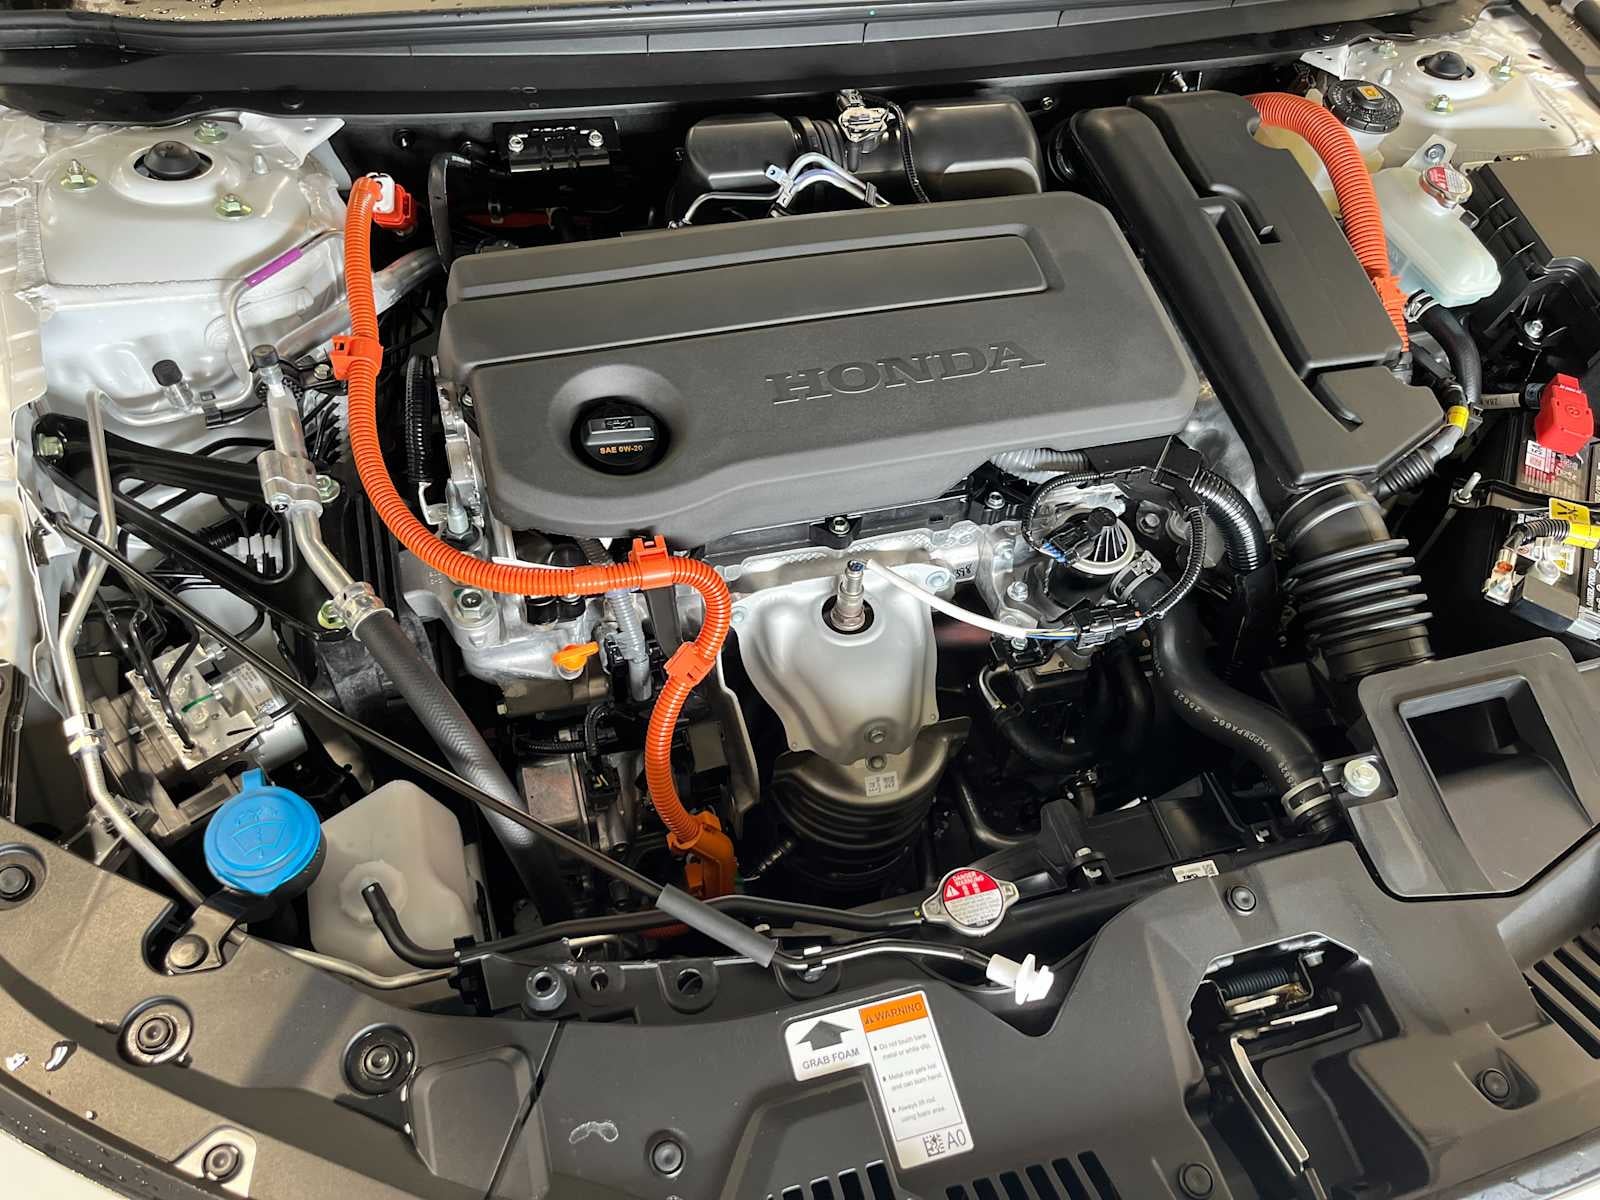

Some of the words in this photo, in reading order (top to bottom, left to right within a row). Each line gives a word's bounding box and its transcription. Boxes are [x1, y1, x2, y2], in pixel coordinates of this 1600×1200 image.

[765, 341, 1047, 405] HONDA
[618, 445, 643, 453] 0W-20
[953, 871, 976, 881] DANGER
[875, 1002, 923, 1021] WARNING
[888, 1040, 898, 1048] not
[802, 1056, 830, 1070] GRAB
[832, 1048, 860, 1062] FOAM
[888, 1072, 904, 1080] Metal
[892, 1083, 902, 1092] and
[898, 1102, 917, 1112] Always
[947, 1129, 967, 1149] A0
